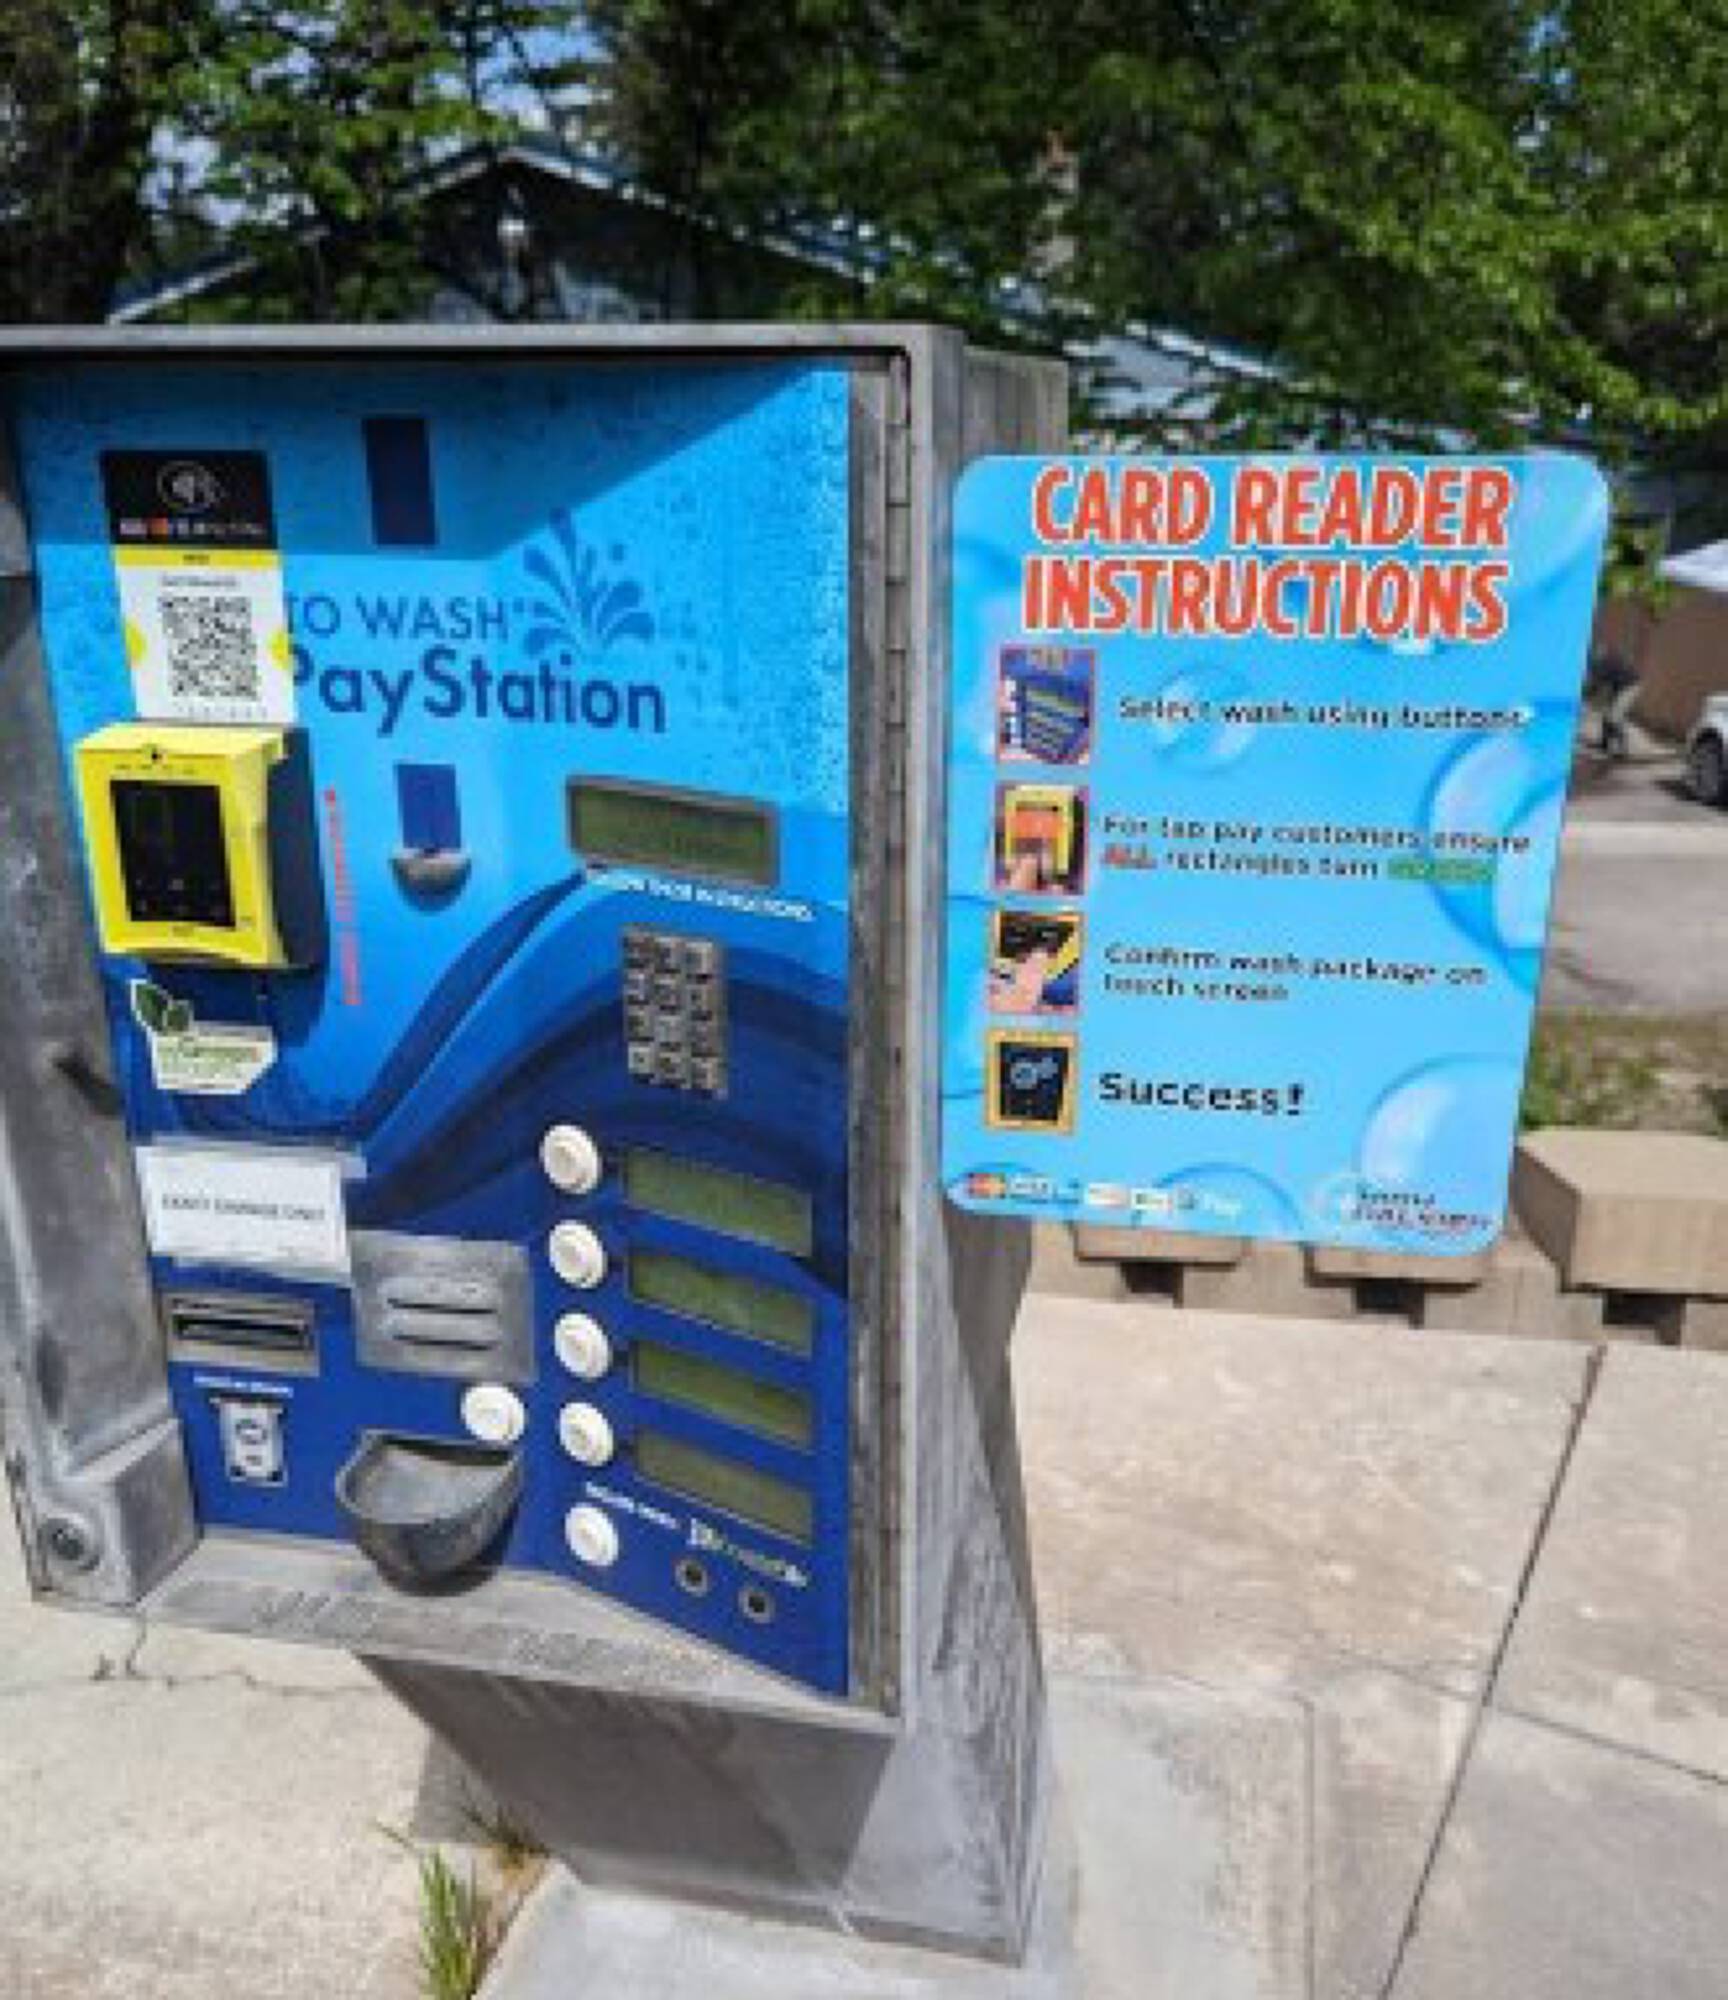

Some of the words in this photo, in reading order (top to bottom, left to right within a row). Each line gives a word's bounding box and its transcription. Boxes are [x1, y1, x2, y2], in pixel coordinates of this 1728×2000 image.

[1030, 464, 1214, 548] CARD
[1231, 464, 1513, 552] READER
[355, 594, 510, 641] WASH
[1022, 557, 1509, 642] INSTRUCTIONS
[1119, 695, 1211, 724] Select
[1220, 699, 1299, 725] wash
[1307, 697, 1390, 728] using
[1103, 815, 1149, 835] For
[1161, 815, 1206, 841] tap
[1213, 821, 1265, 844] pay
[1271, 824, 1423, 848] customers
[1434, 832, 1531, 854] ensure
[1166, 848, 1311, 878] rectangles
[1318, 857, 1379, 879] turn
[1104, 943, 1221, 970] Confirm
[1230, 953, 1302, 974] wash
[1312, 957, 1436, 984] package
[1445, 967, 1488, 986] on
[1193, 983, 1289, 1003] screen
[1099, 1072, 1304, 1116] Success!
